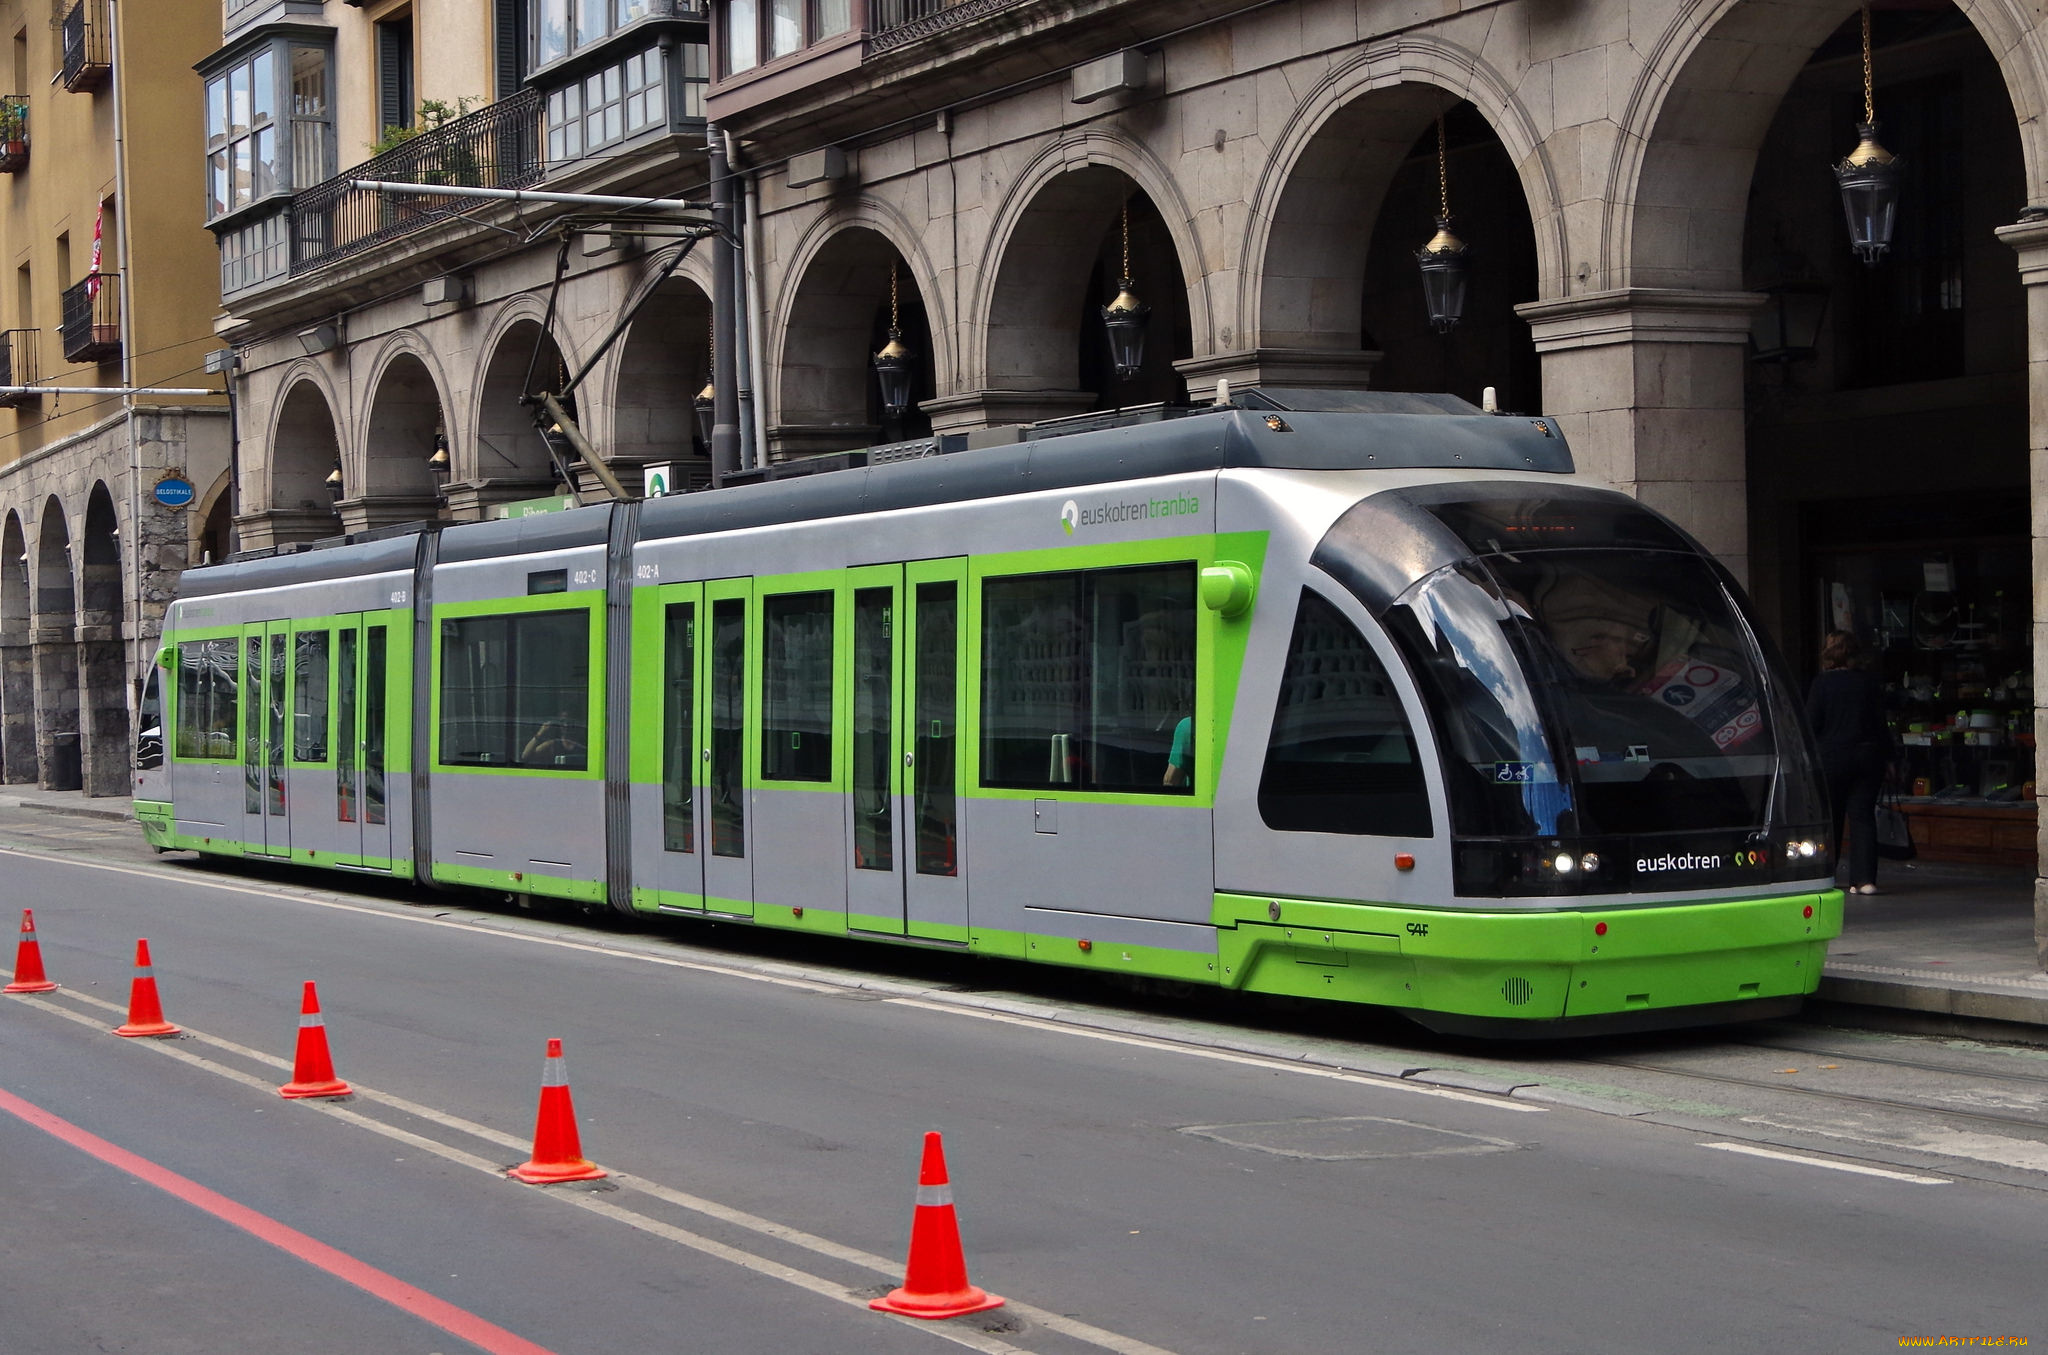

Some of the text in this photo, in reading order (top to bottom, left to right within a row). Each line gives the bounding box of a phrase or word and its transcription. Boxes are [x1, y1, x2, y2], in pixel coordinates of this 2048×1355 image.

[1081, 490, 1199, 526] euskotren tranbia
[1636, 852, 1721, 872] euskotren
[1406, 922, 1429, 937] CAF
